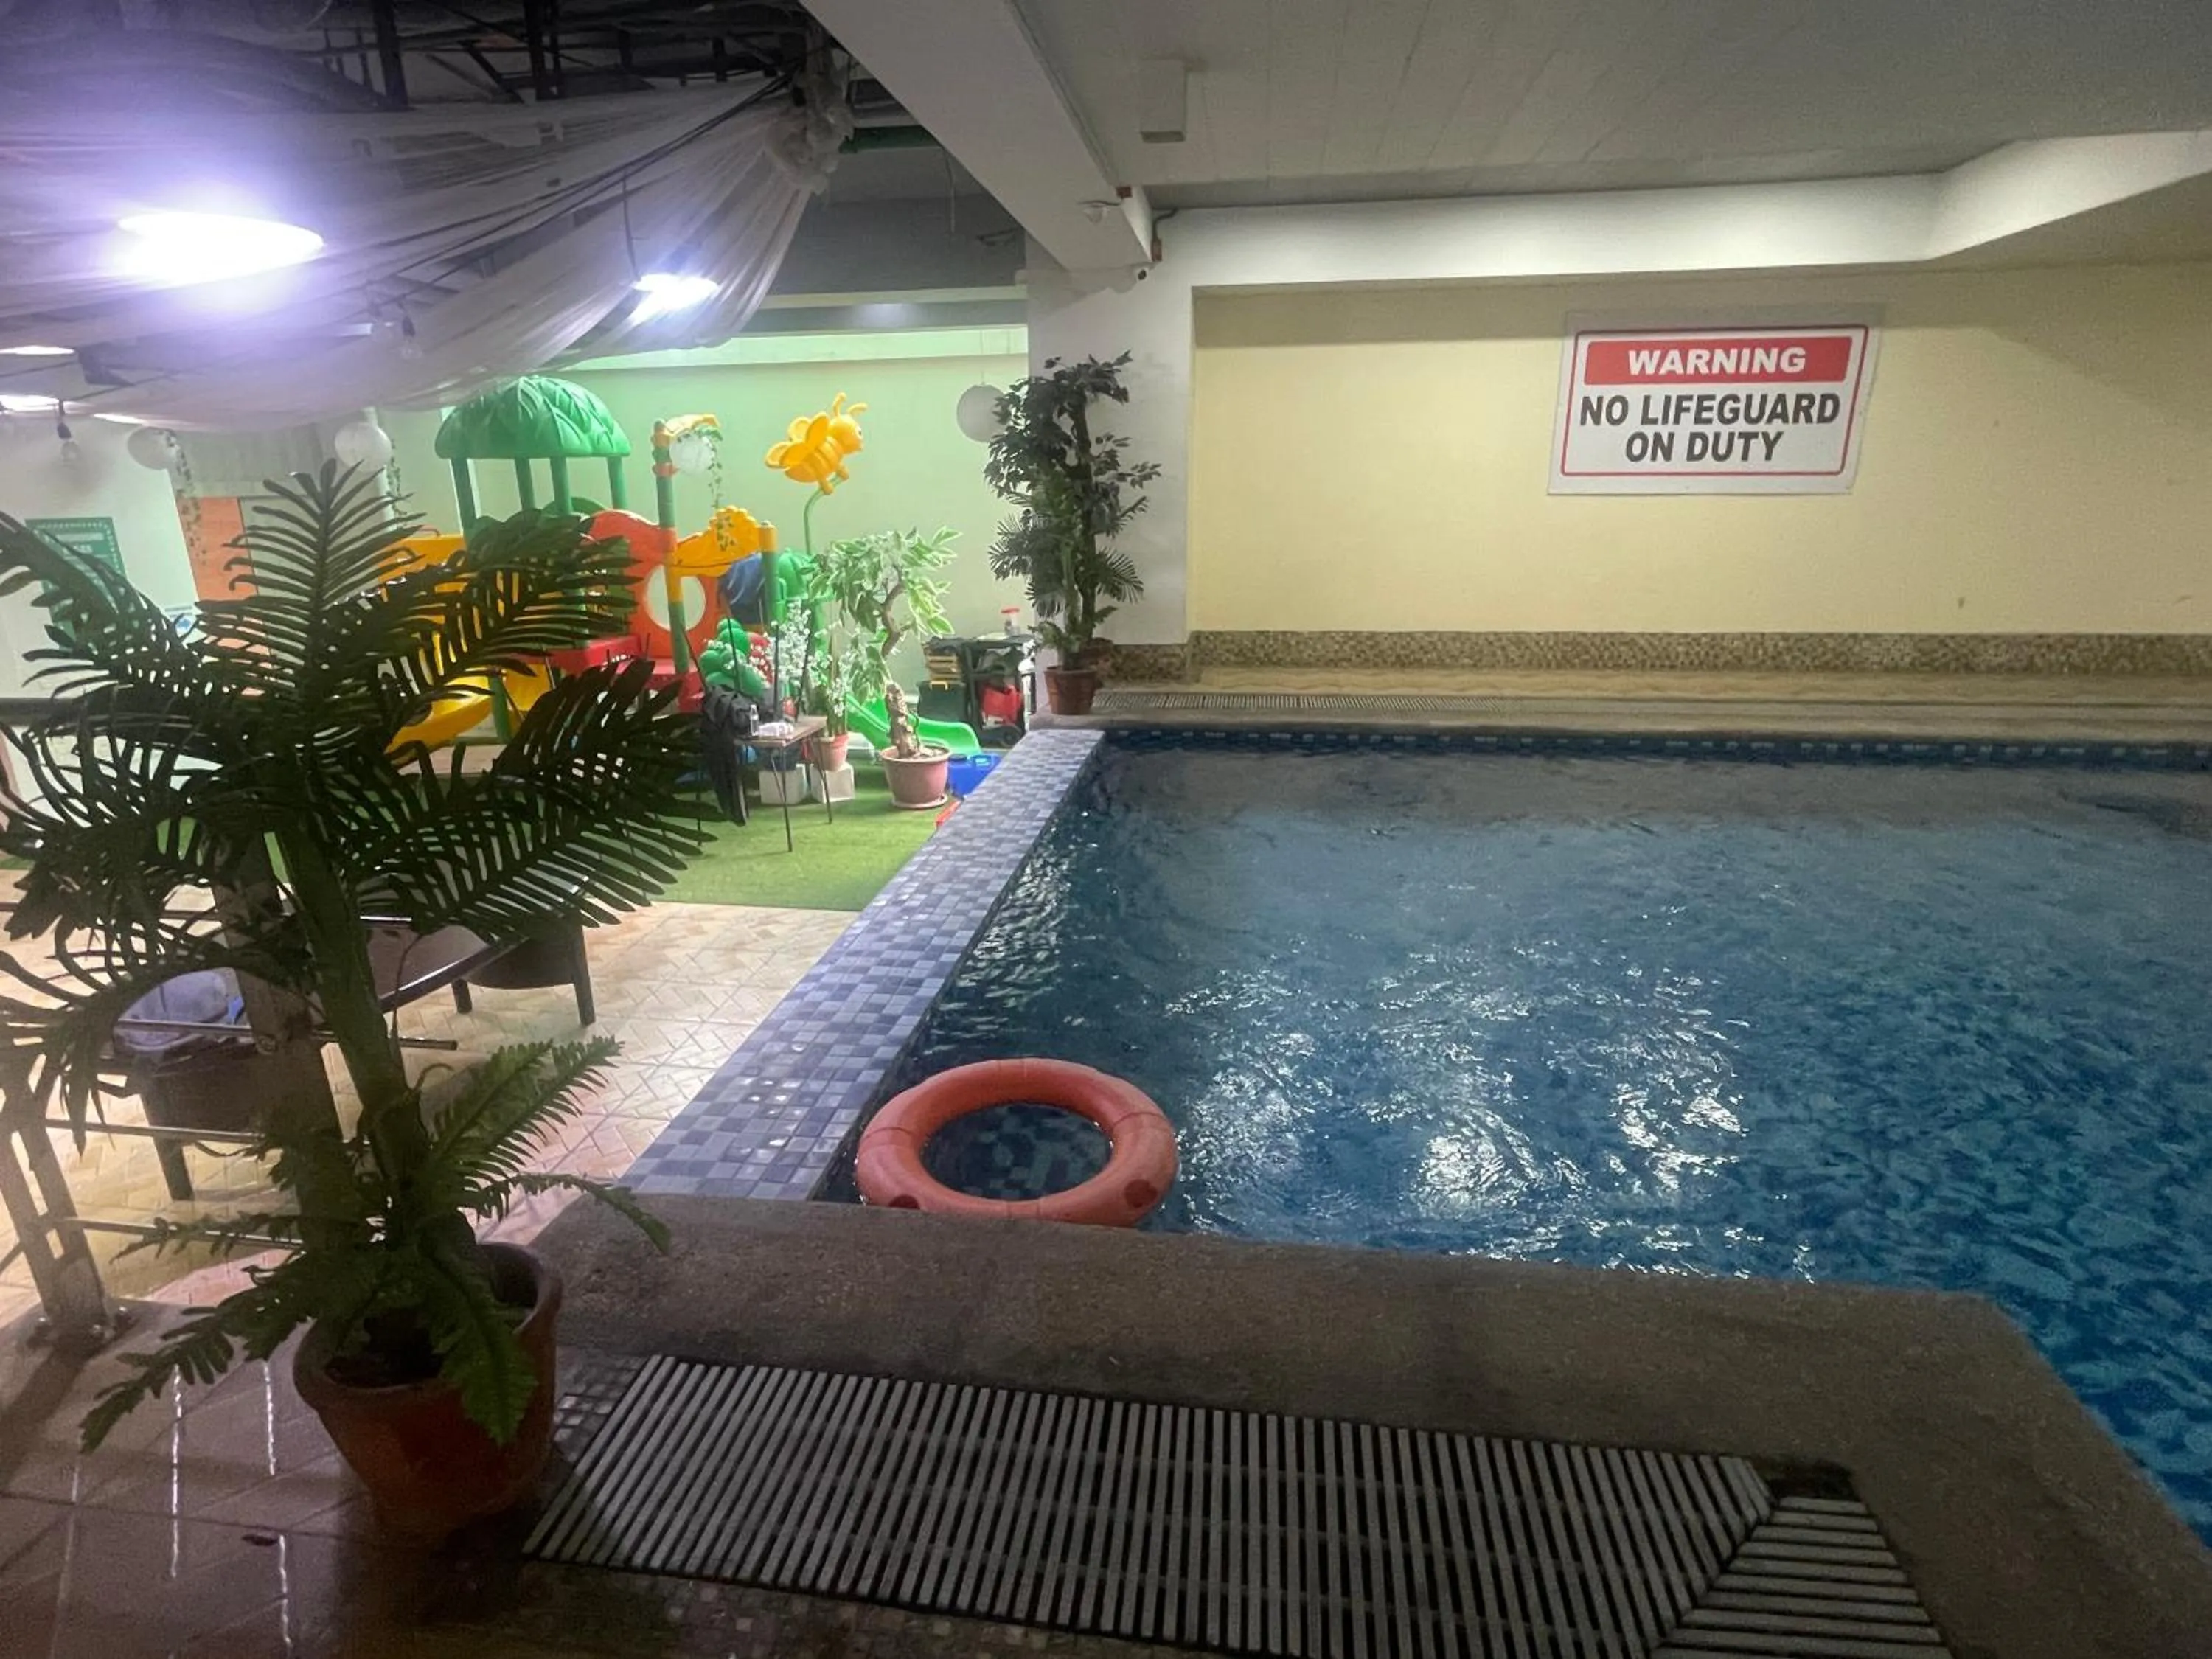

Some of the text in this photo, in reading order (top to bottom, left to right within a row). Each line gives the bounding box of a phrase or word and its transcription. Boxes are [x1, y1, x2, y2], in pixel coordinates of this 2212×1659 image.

[1628, 347, 1806, 375] WARNING
[1580, 393, 1840, 425] NO LIFEGUARD
[1625, 431, 1784, 462] ON DUTY
